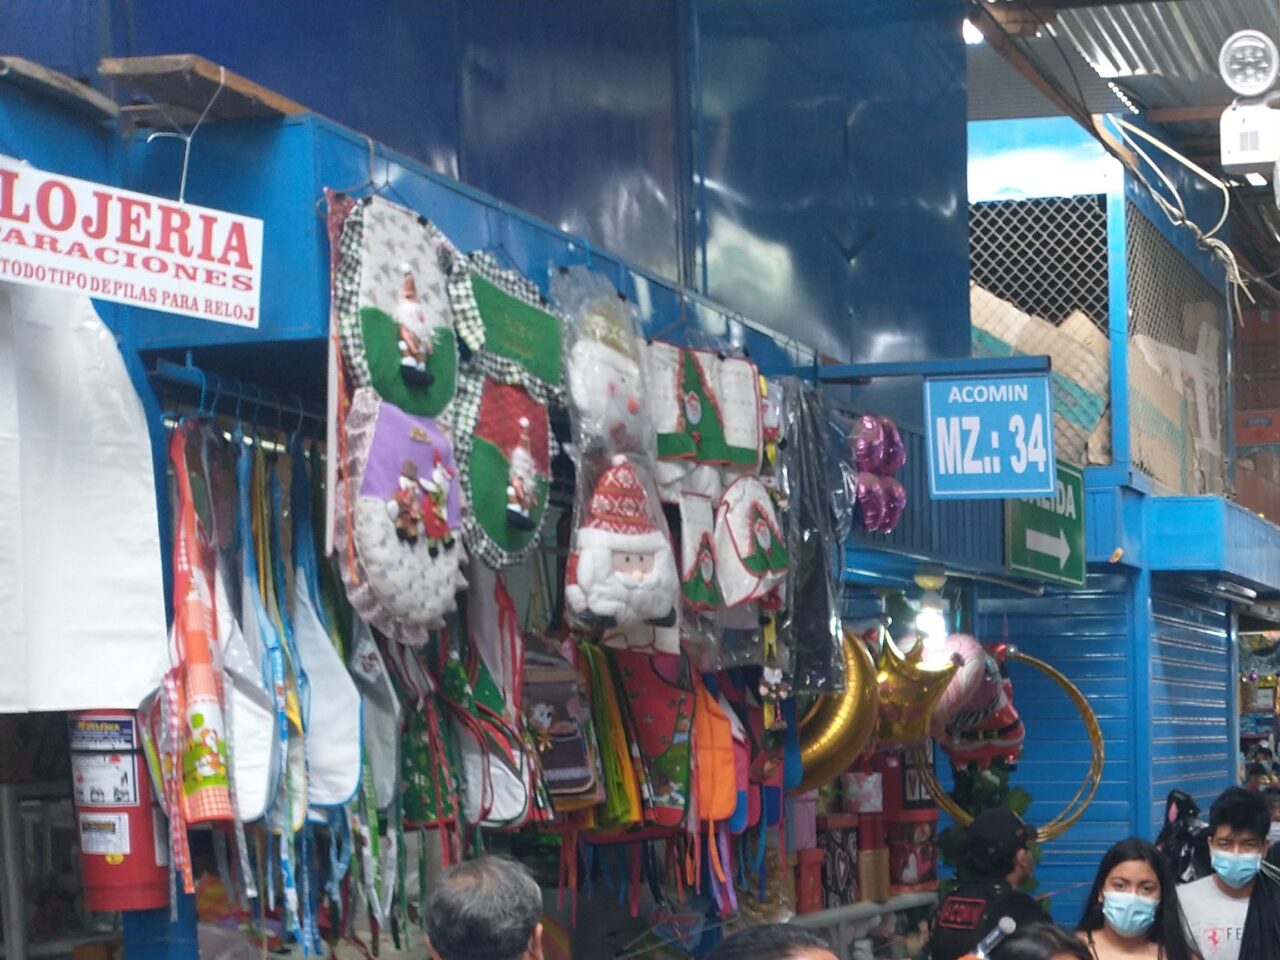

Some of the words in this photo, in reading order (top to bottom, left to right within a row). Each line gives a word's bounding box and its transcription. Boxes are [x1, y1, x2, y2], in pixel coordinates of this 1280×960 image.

[0, 227, 254, 293] ARACIONES
[1, 256, 47, 282] TODO
[48, 267, 87, 290] TIPO
[112, 281, 158, 305] PILAS
[161, 291, 200, 312] PARA
[204, 299, 256, 322] RELOJ
[948, 384, 1028, 404] ACOMIN
[936, 416, 1001, 475] MZ.:
[1008, 413, 1047, 475] 34
